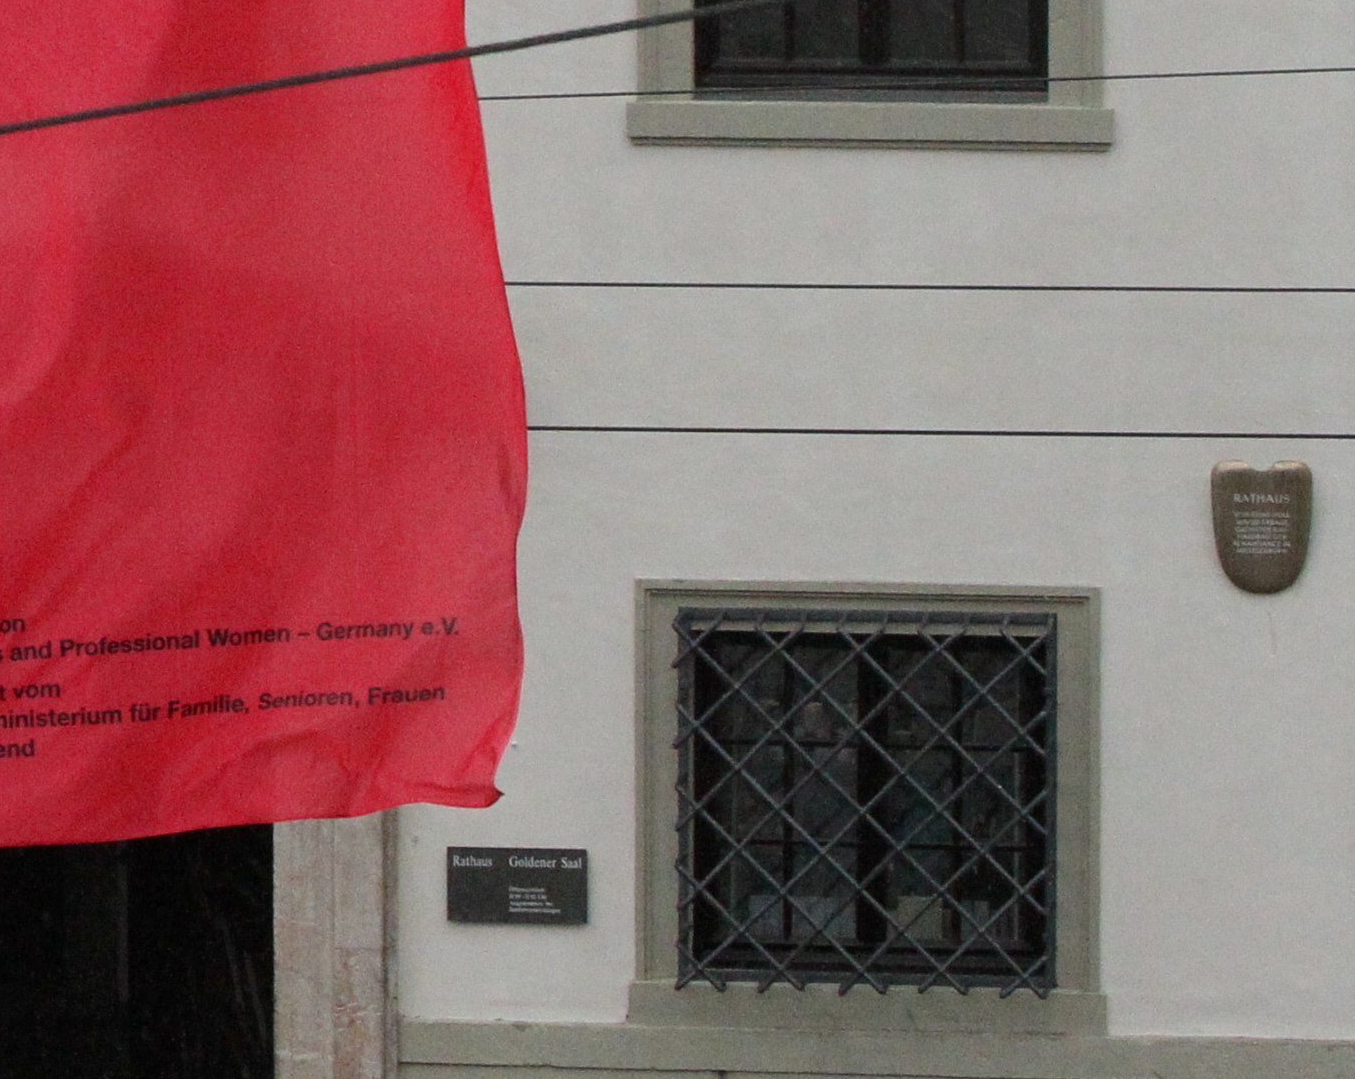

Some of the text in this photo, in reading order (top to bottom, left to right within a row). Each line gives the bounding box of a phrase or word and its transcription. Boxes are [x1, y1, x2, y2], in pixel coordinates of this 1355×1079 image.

[1233, 493, 1290, 504] RATHAUS
[10, 640, 52, 660] and
[60, 629, 200, 657] Professional
[207, 627, 291, 647] Women
[316, 621, 414, 640] Germany
[13, 682, 61, 699] vom
[130, 702, 161, 722] für
[168, 694, 249, 719] Familie,
[258, 690, 360, 710] Senioren,
[367, 685, 446, 706] Frauen
[452, 855, 583, 869] Rathaus Goldener Saal
